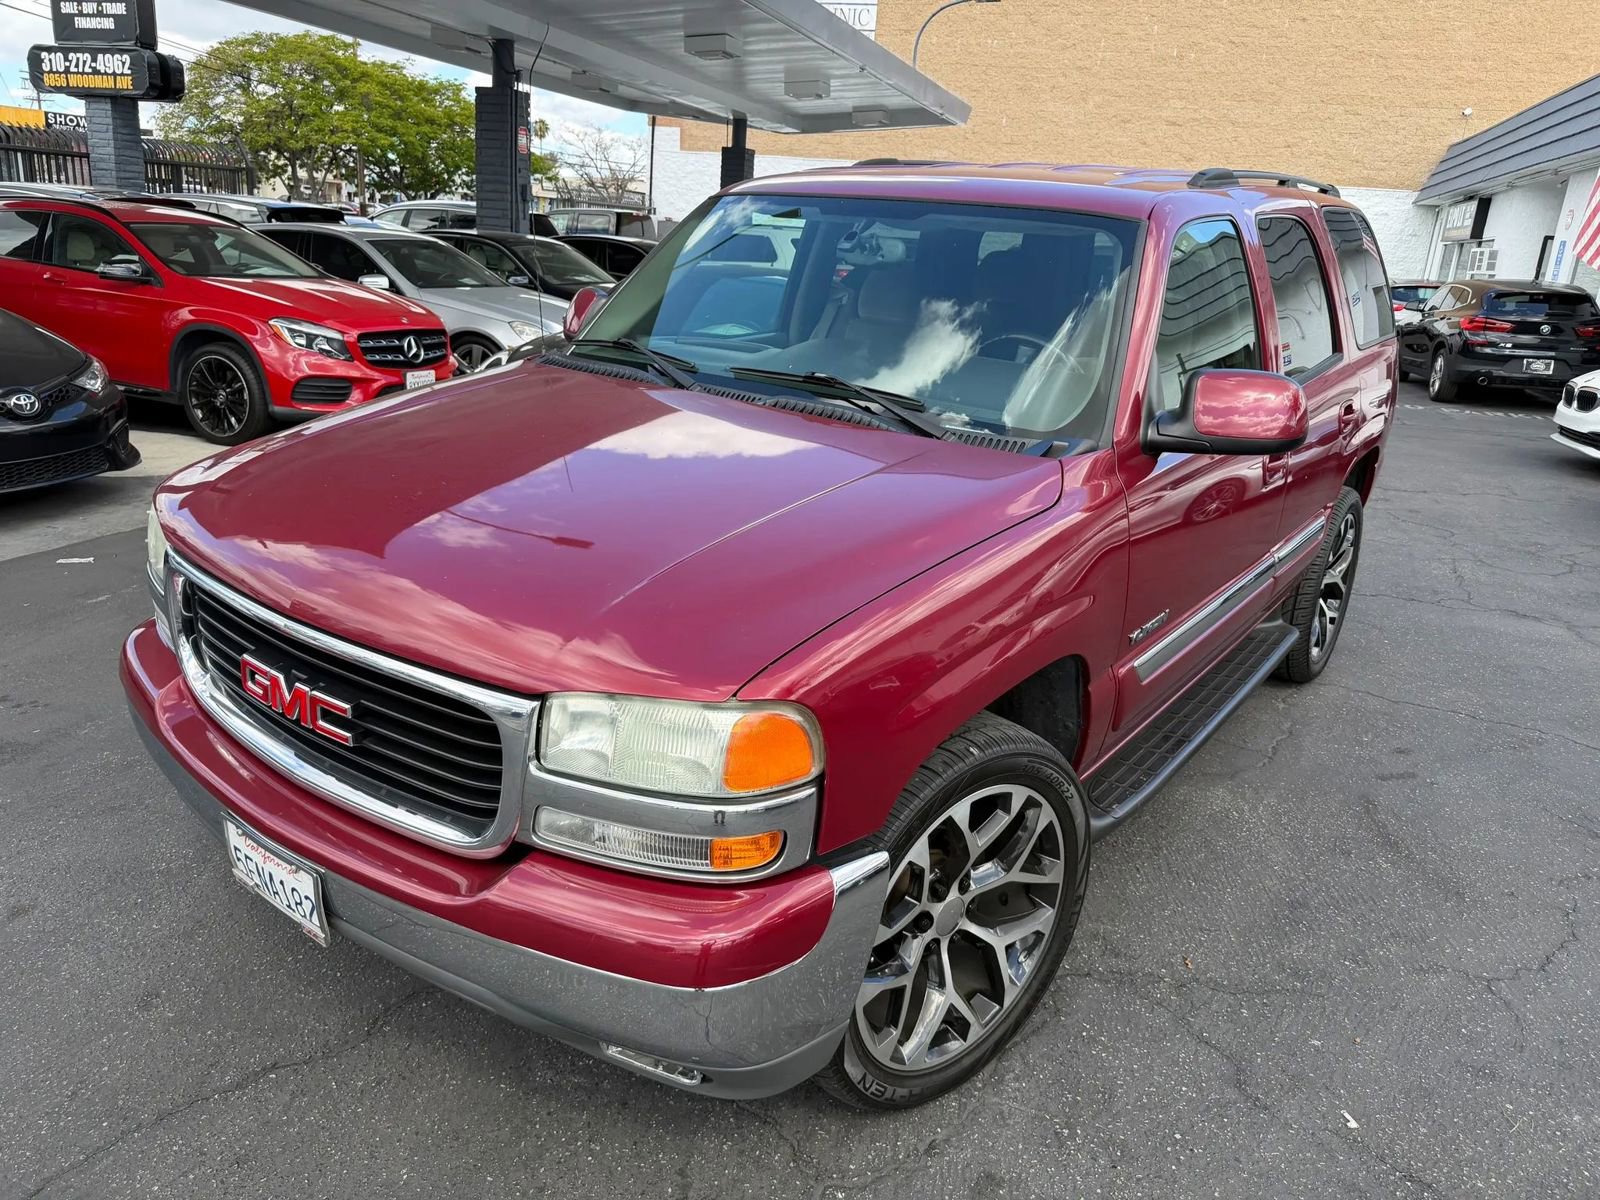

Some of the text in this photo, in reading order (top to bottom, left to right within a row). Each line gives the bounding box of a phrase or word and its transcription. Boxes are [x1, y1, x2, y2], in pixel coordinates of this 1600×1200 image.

[60, 2, 126, 14] SALE BUY TRADE
[74, 17, 114, 29] FINANCING
[41, 52, 131, 74] 310-272-4962
[44, 73, 133, 89] 8856 WOODMAN AVE
[47, 112, 88, 128] SHOW
[240, 653, 353, 747] GMC
